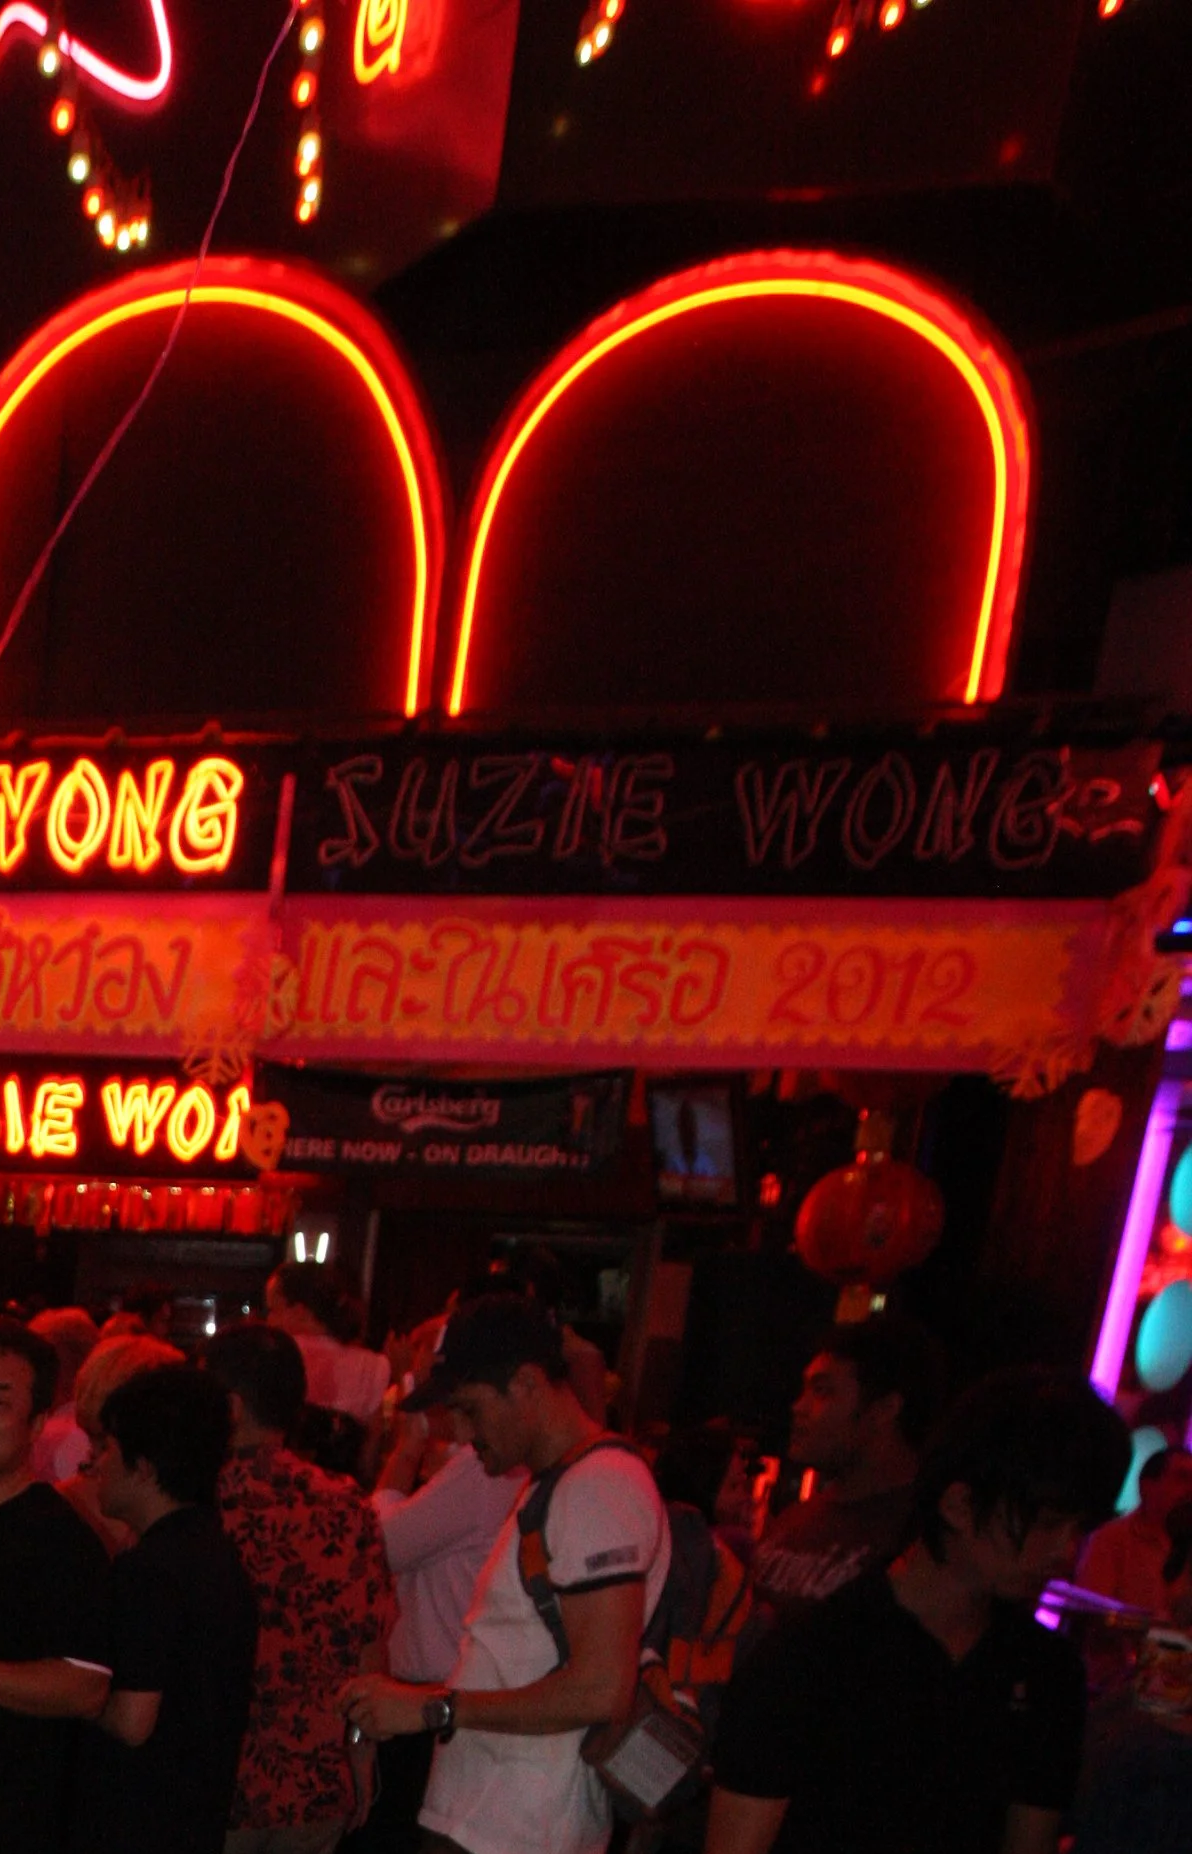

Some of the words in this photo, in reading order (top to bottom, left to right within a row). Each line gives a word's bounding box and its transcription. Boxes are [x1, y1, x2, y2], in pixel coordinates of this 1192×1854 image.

[317, 752, 675, 868] SUZIE
[734, 748, 1064, 870] WONG
[766, 944, 978, 1026] 2012
[369, 1083, 502, 1134] Carlsberg
[341, 1140, 404, 1164] NOW
[423, 1142, 459, 1165] ON
